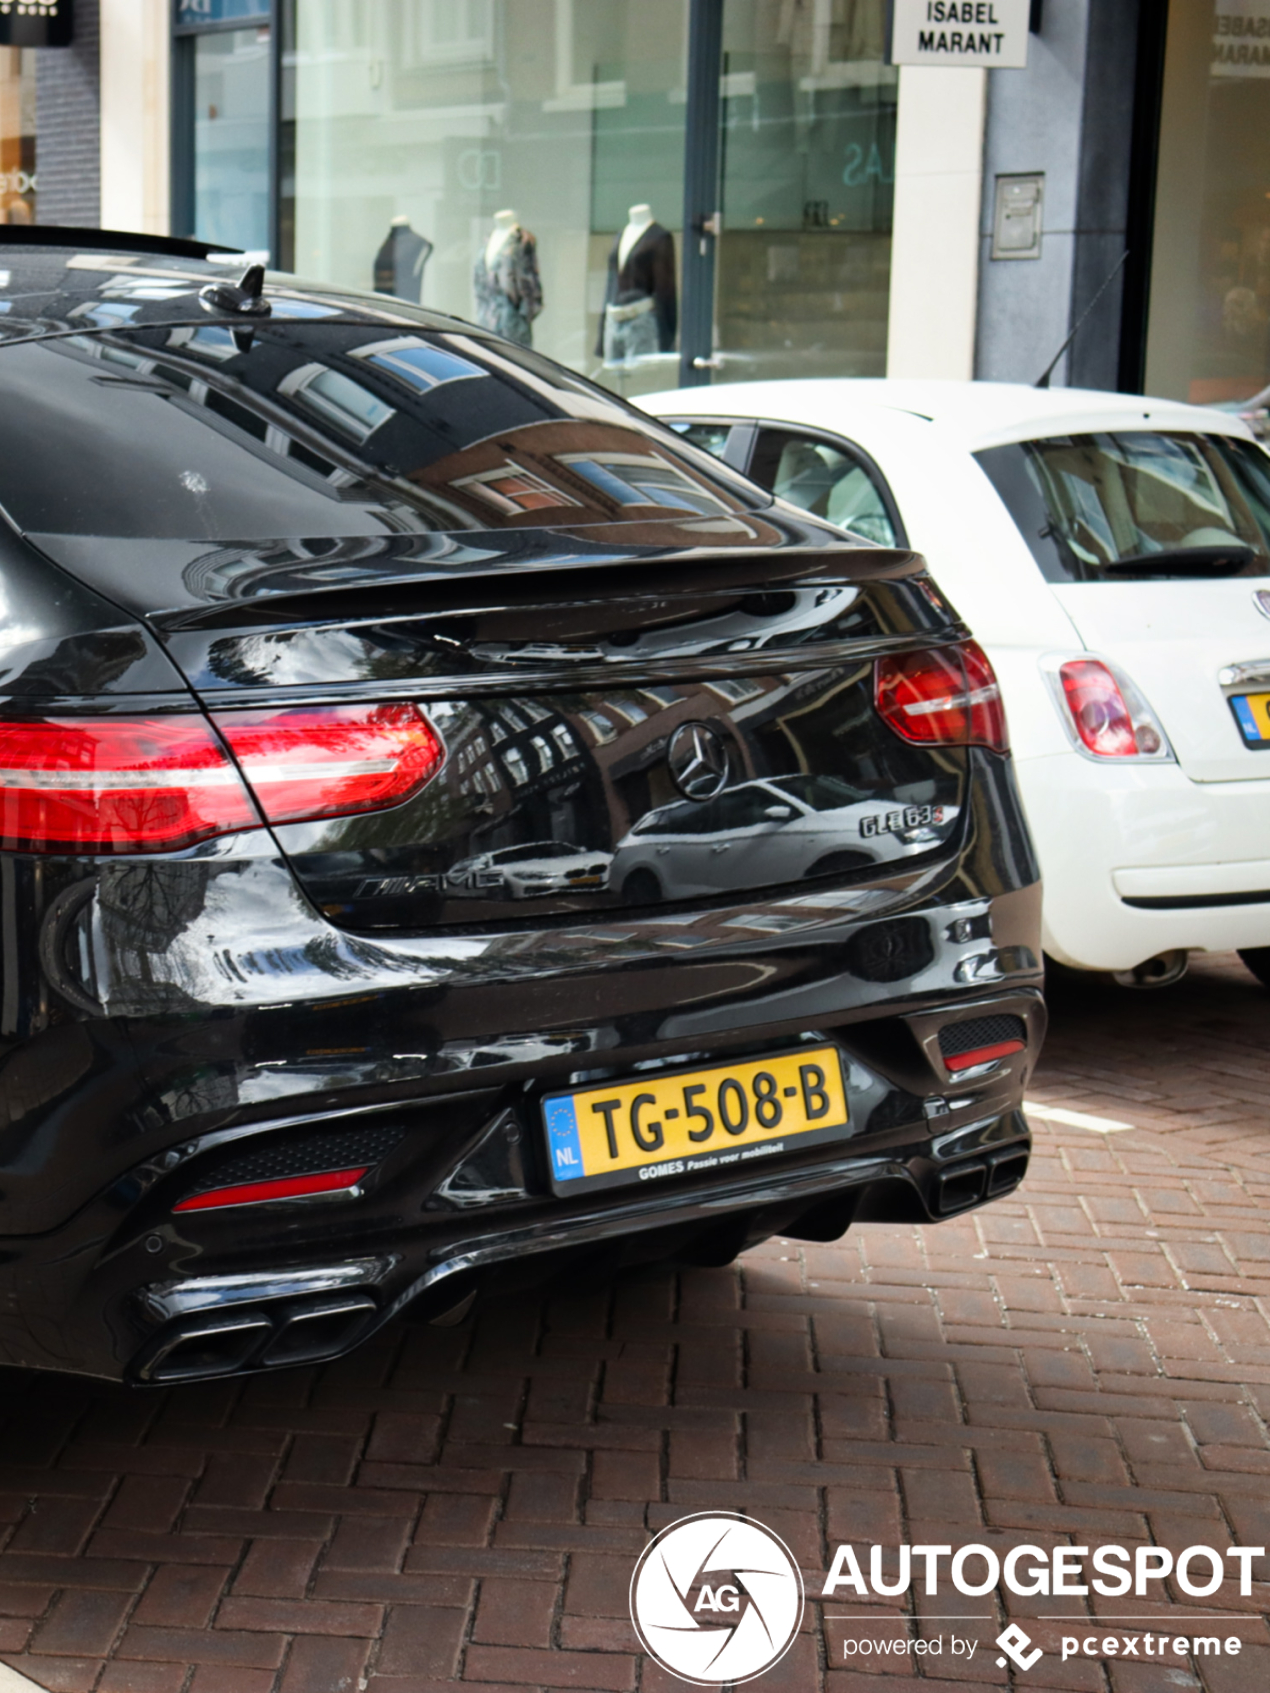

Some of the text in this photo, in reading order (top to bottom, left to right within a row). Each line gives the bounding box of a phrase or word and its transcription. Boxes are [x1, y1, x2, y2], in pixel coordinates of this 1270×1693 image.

[927, 1, 998, 24] ISABEL
[918, 30, 1005, 54] MARANT
[407, 870, 505, 894] AMG
[592, 1063, 830, 1159] TG-508-B
[556, 1147, 579, 1167] NL
[638, 1142, 784, 1180] GOMES Passie voor mobiliteit
